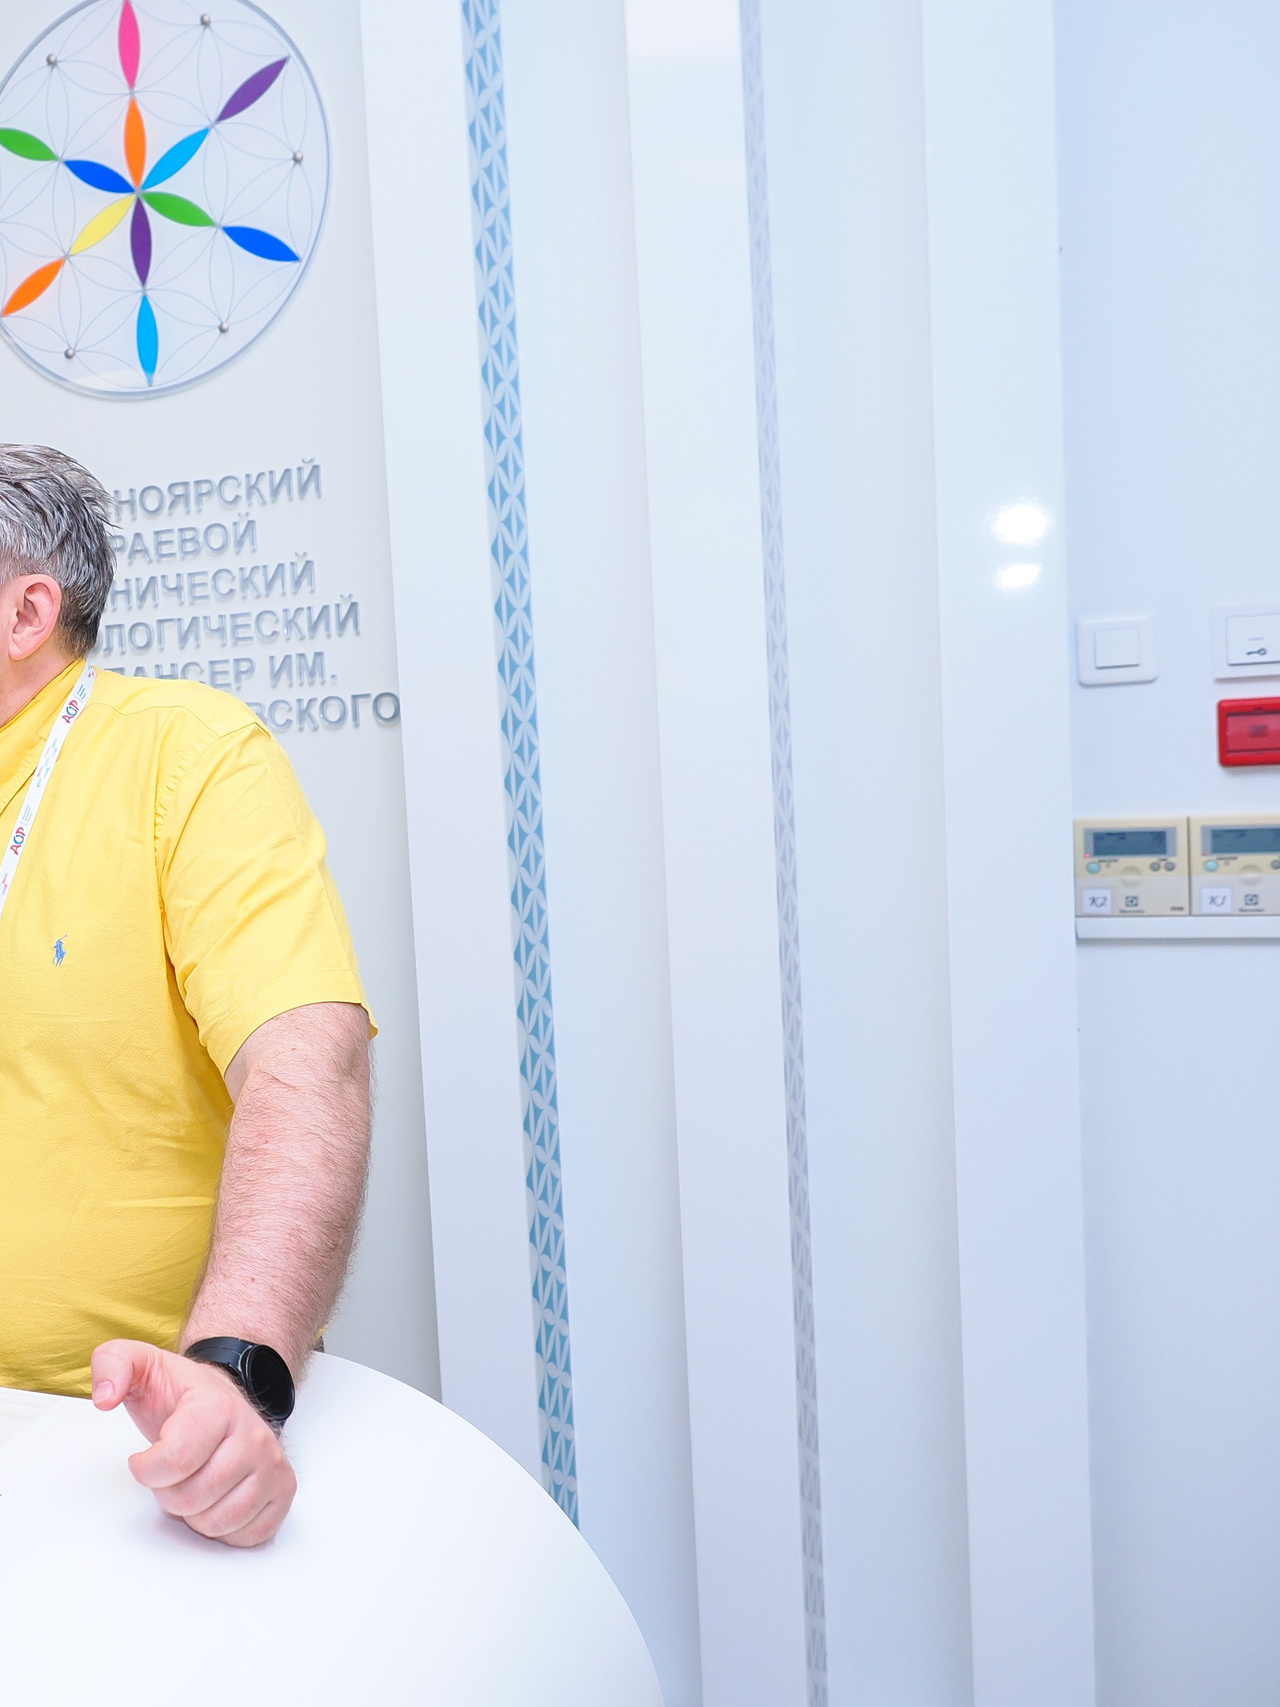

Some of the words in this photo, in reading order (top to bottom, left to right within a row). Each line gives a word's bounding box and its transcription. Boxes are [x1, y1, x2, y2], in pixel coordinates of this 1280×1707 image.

[108, 458, 322, 523] НОЯРСКИЙ
[109, 511, 258, 566] РАЕВОЙ
[109, 551, 316, 612] НИЧЕСКИЙ
[269, 651, 338, 688] ИМ.
